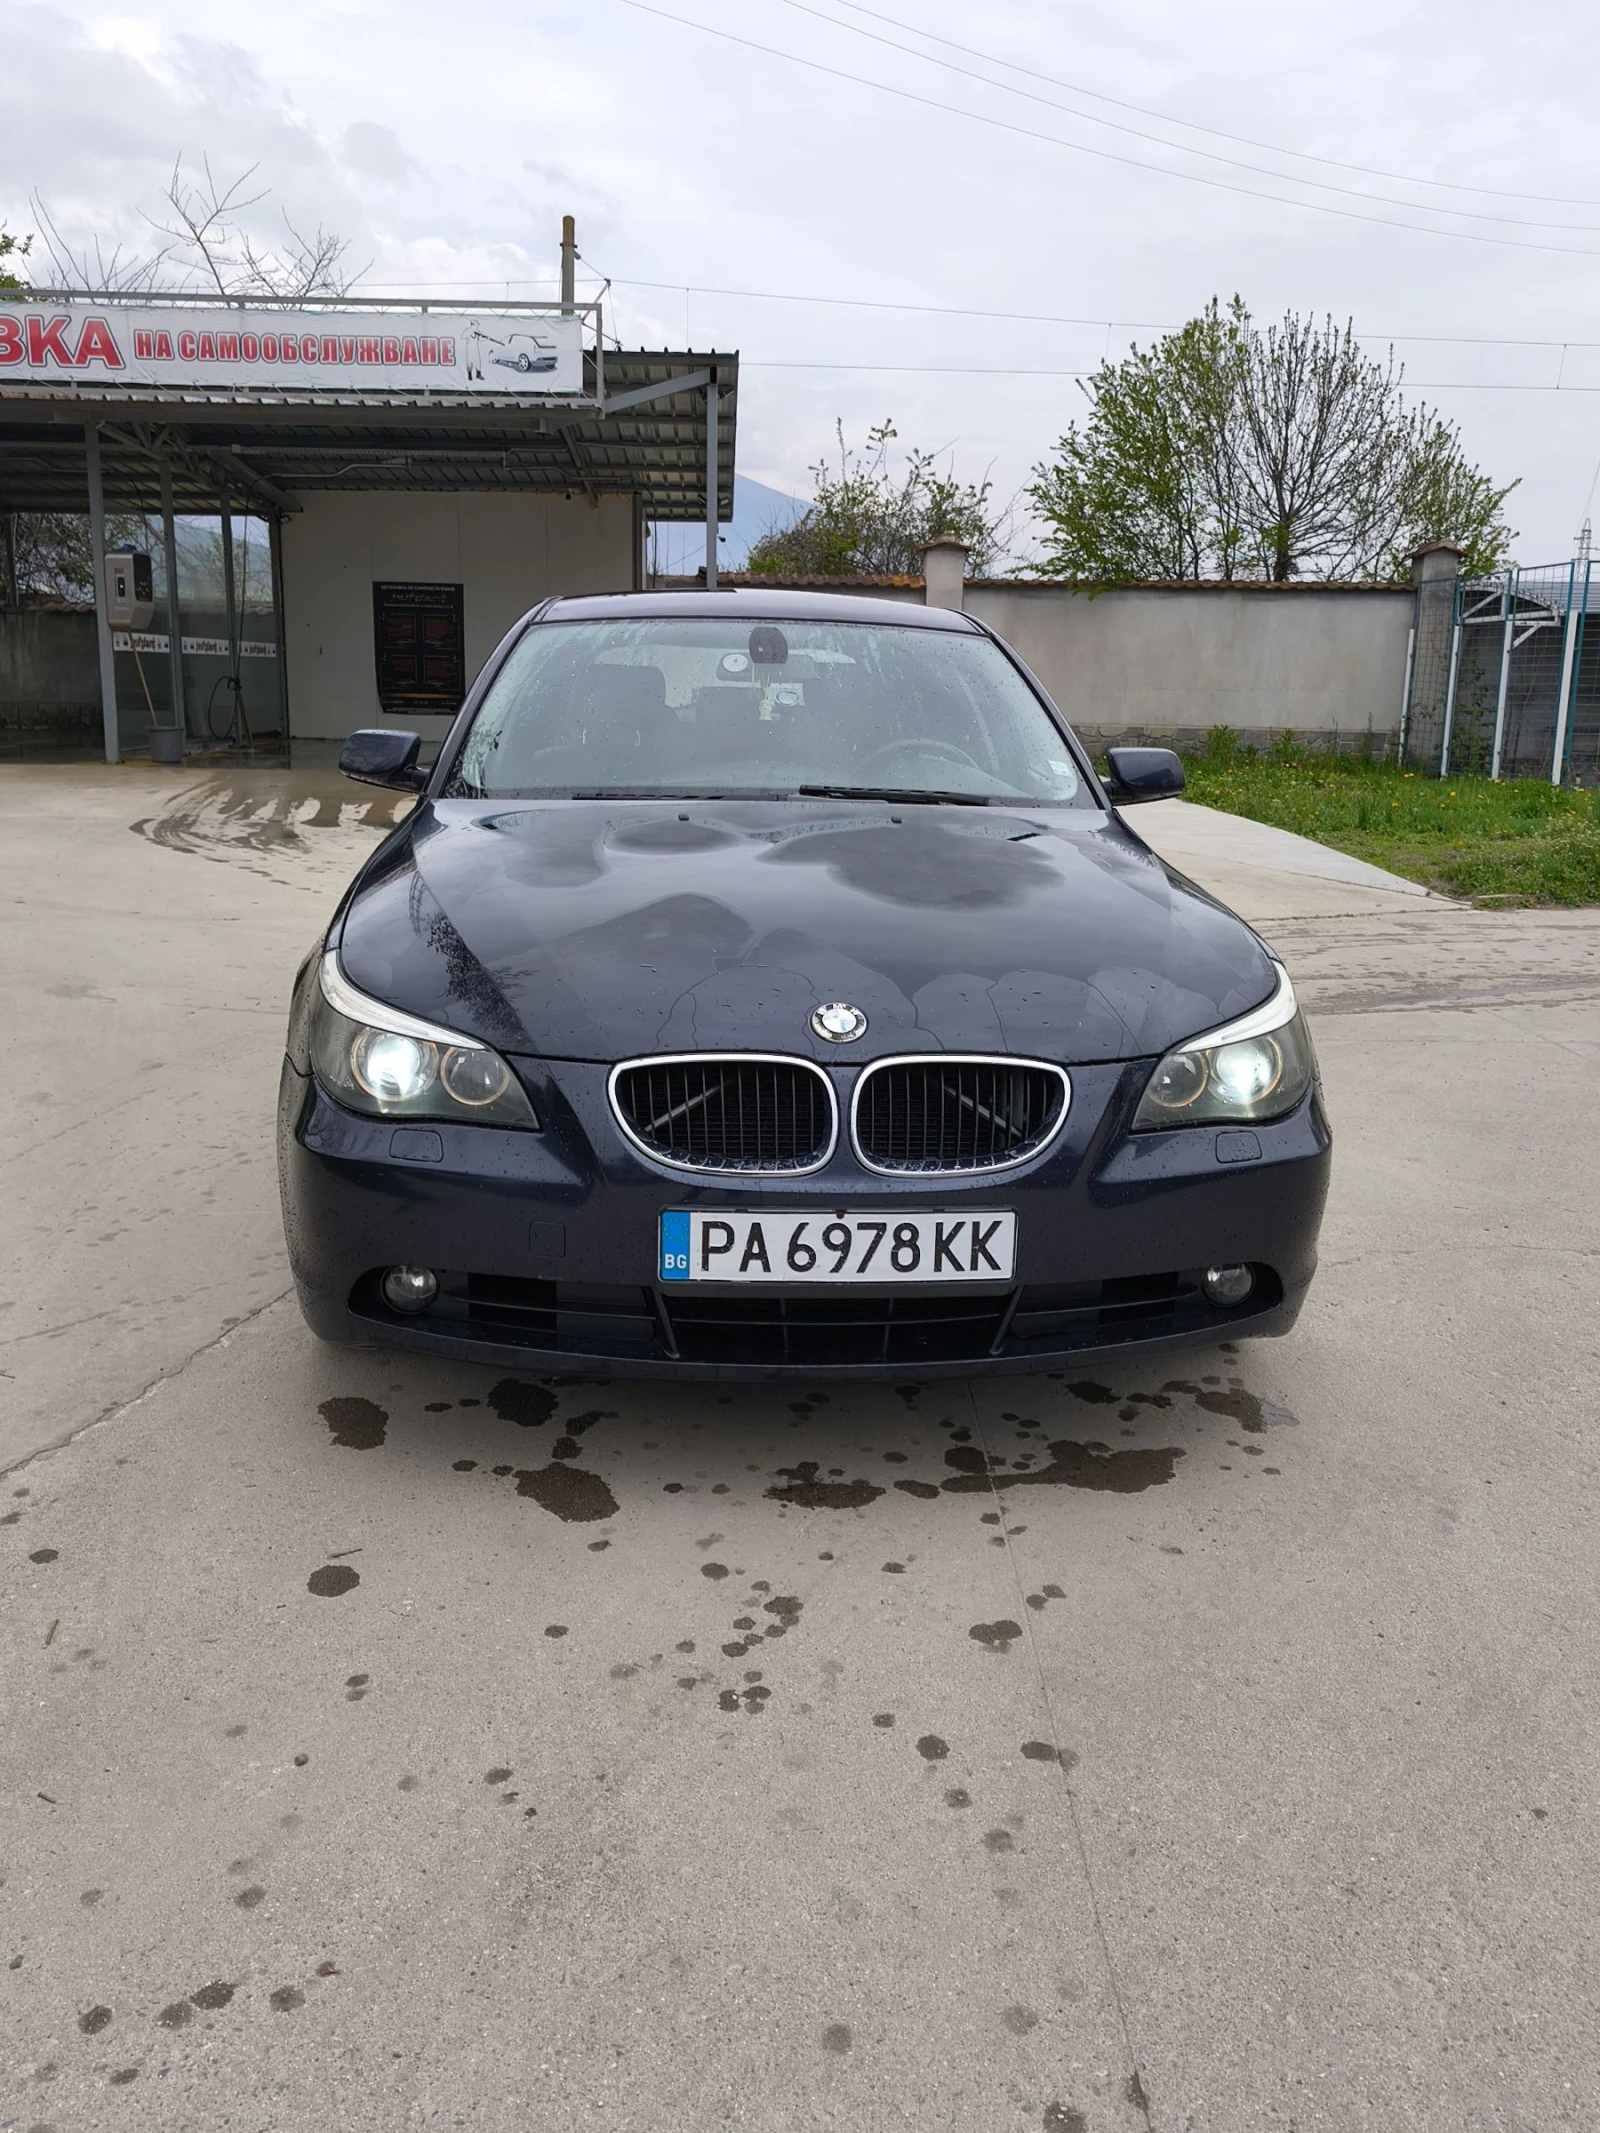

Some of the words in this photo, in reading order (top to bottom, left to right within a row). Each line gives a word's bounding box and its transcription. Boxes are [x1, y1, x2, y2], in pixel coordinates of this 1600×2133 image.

[0, 315, 124, 369] ВКА
[134, 329, 174, 361] НА
[178, 330, 456, 366] САМООБСЛУЖВАНЕ
[664, 1253, 687, 1269] BG
[700, 1220, 772, 1274] PA
[786, 1221, 921, 1274] 6978
[933, 1220, 1003, 1273] KK
